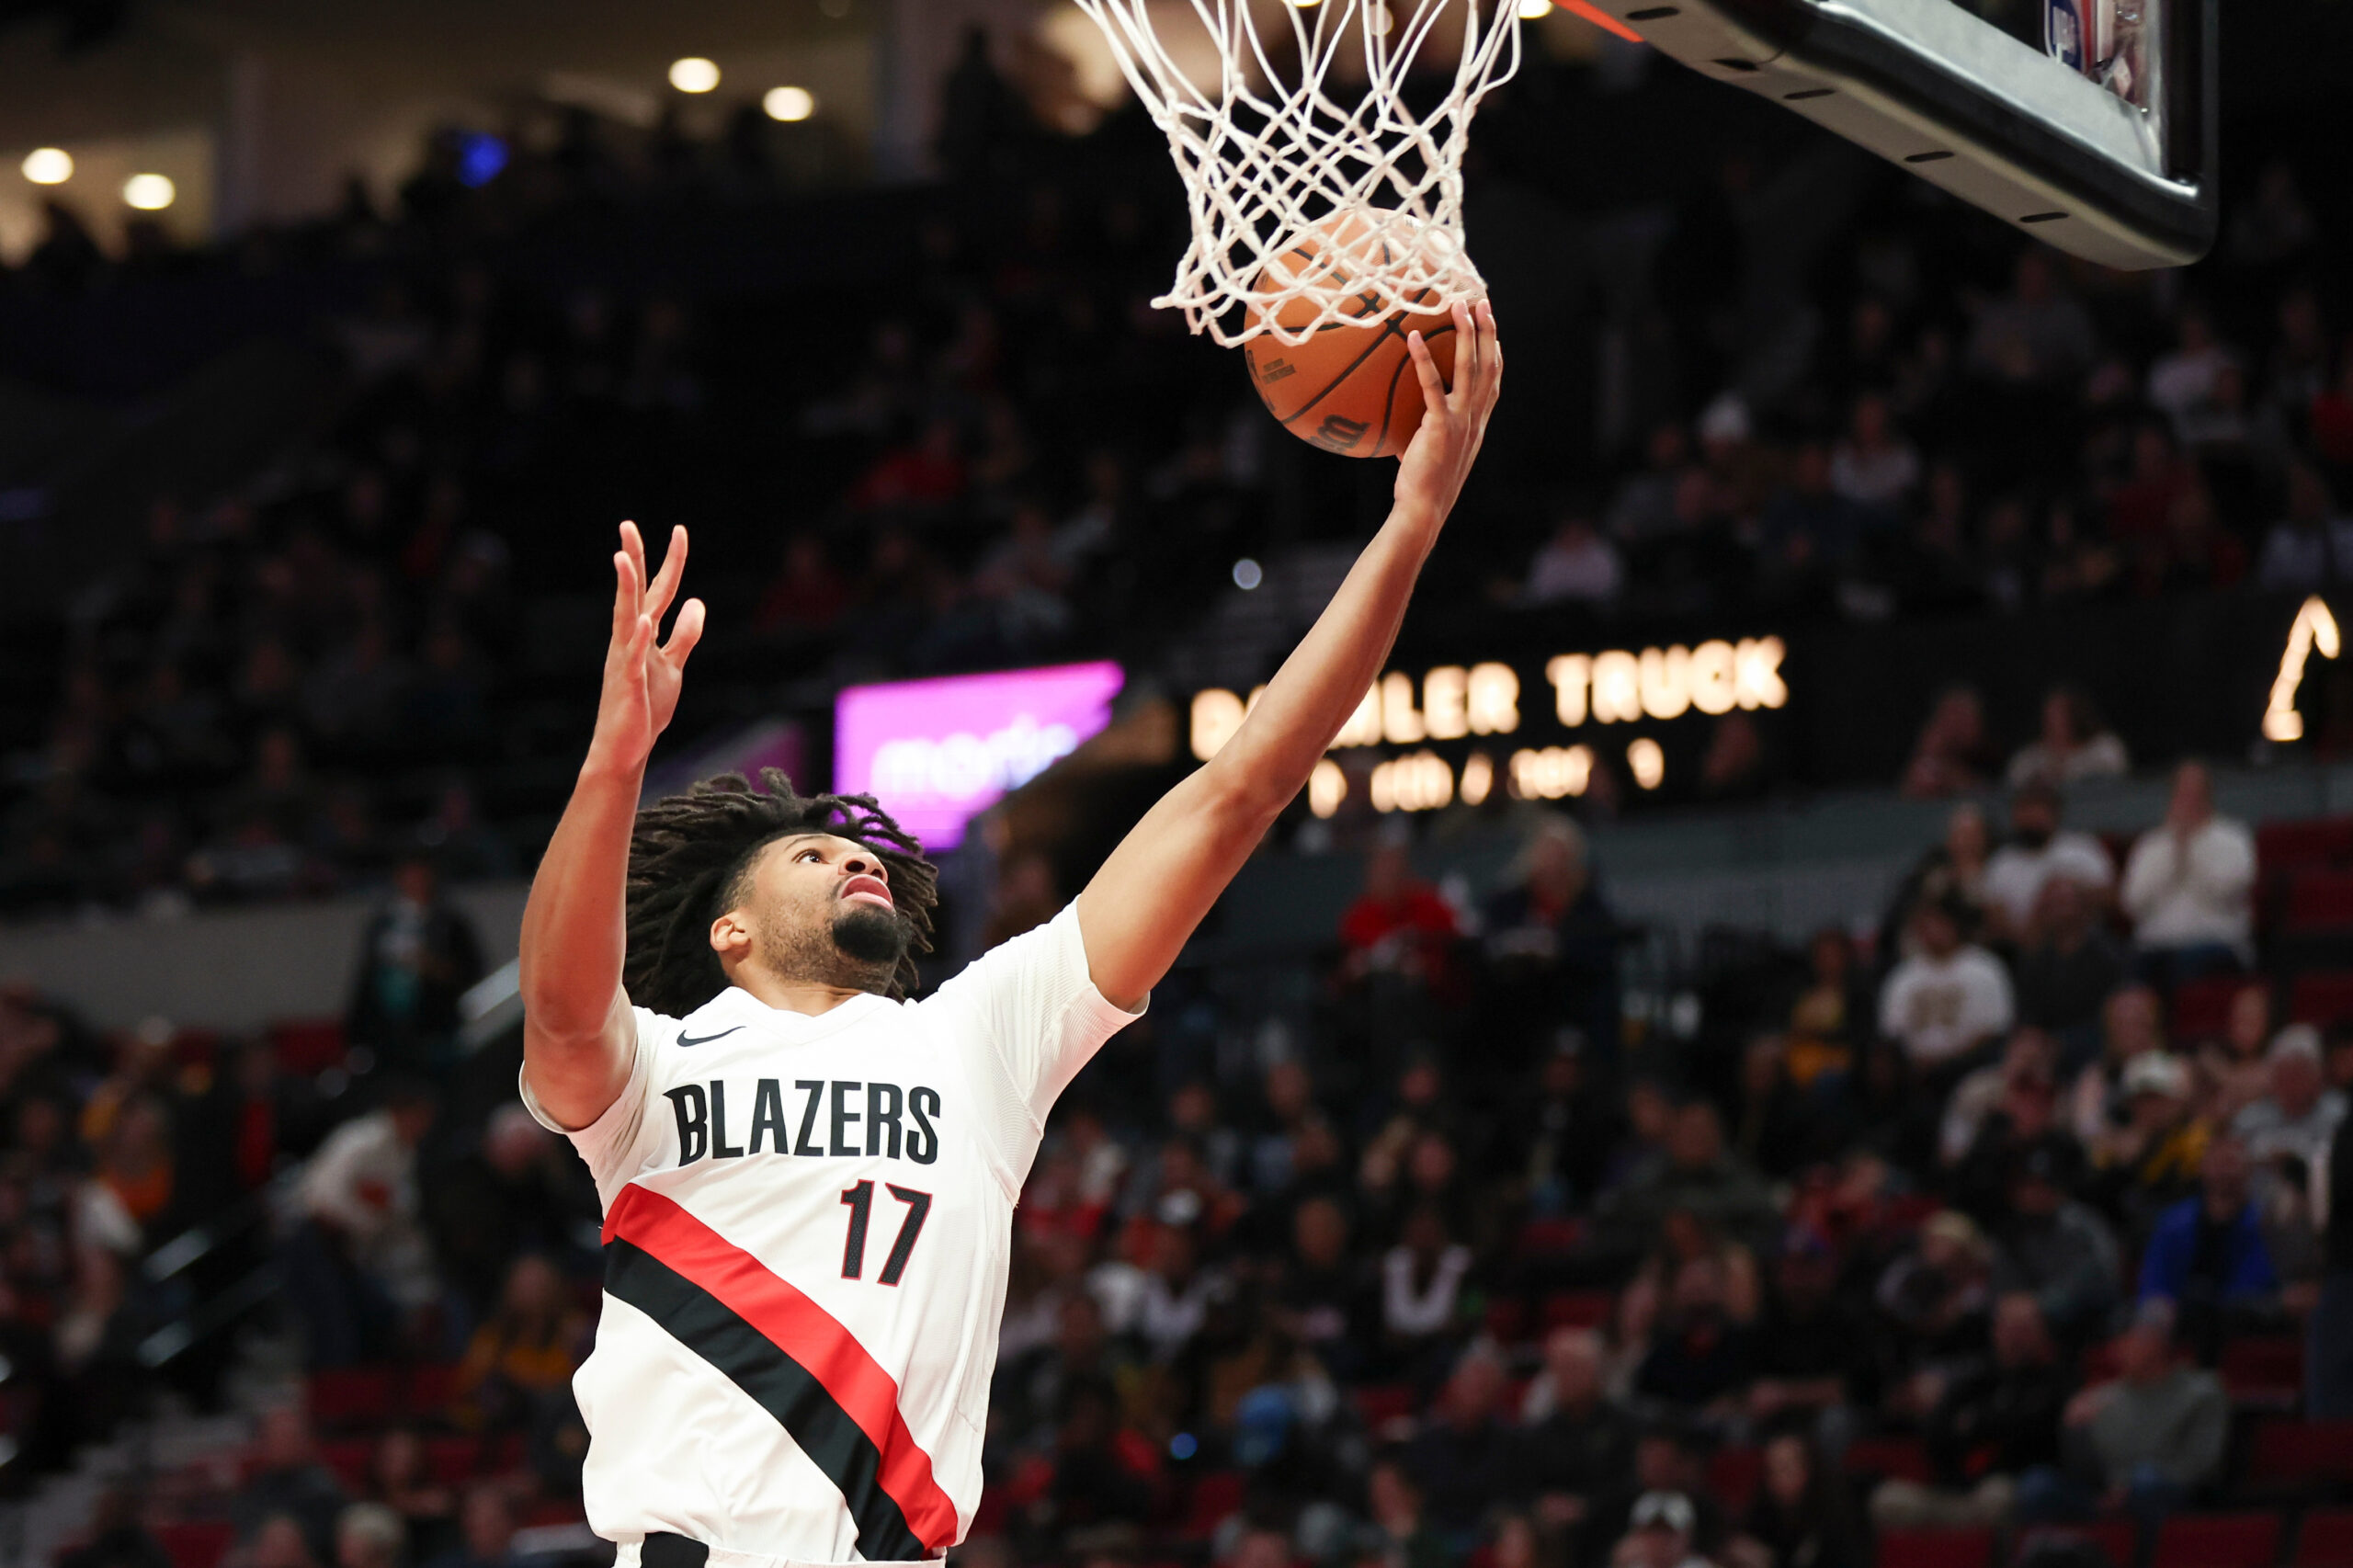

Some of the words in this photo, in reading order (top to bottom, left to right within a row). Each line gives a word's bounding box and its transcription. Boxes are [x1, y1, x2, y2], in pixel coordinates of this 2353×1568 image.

[1547, 635, 1788, 727] TRUCK
[663, 1078, 941, 1167] BLAZERS
[840, 1178, 933, 1288] 17
